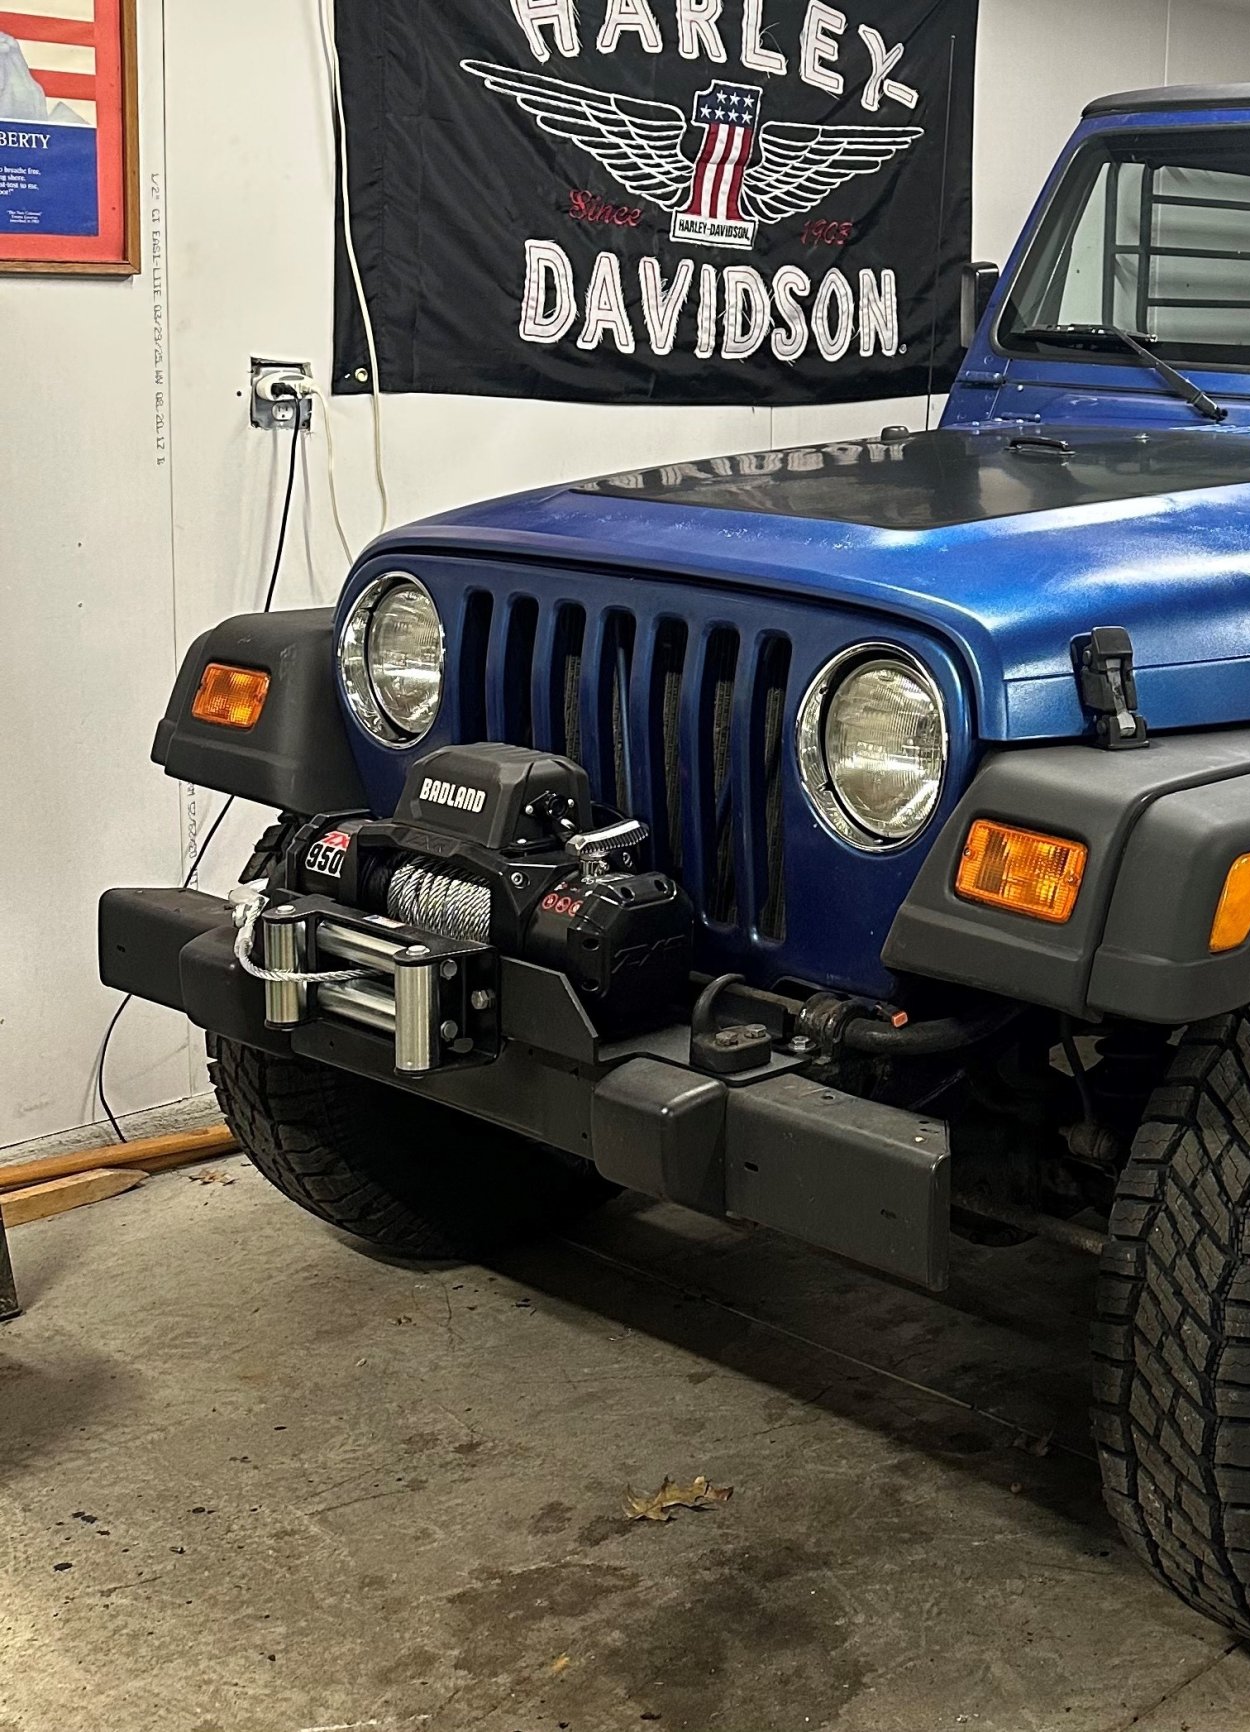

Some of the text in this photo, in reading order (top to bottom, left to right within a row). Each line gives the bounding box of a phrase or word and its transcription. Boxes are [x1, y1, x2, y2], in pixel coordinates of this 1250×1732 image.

[568, 189, 642, 228] Since
[678, 218, 750, 241] HARLEY-DAVIDSON
[519, 239, 899, 362] DAVIDSON
[420, 777, 486, 813] BADLAND
